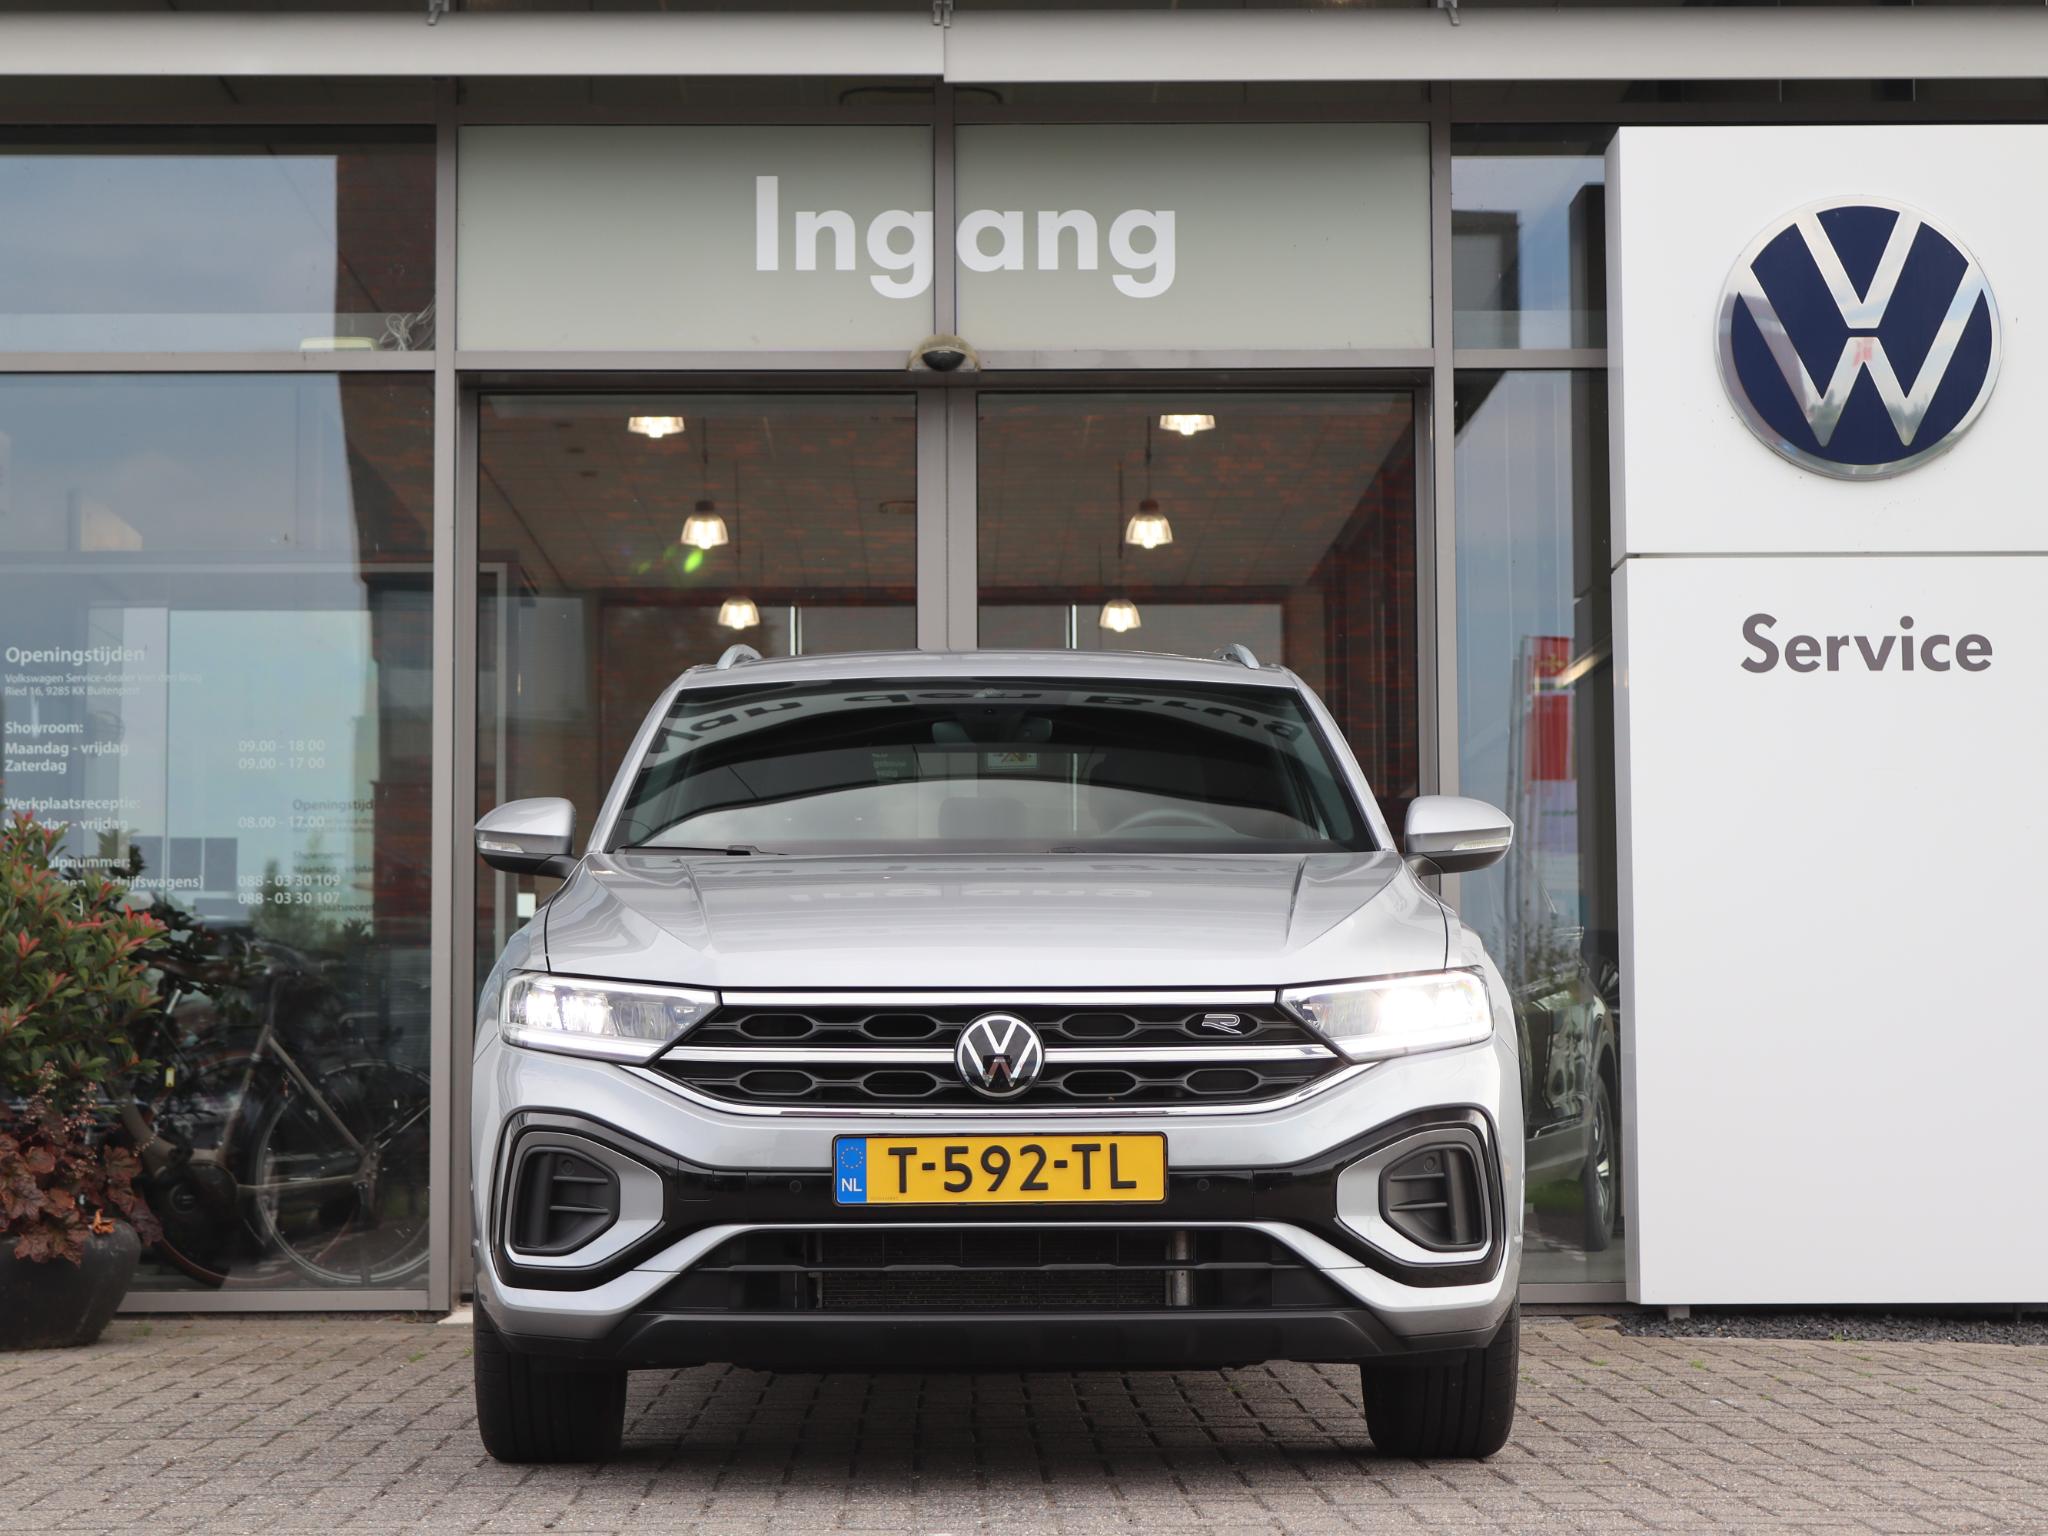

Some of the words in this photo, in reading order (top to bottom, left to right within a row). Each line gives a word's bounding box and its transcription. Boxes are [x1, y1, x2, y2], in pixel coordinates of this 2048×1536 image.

[756, 175, 1176, 299] Ingang
[1741, 613, 1993, 674] Service
[5, 646, 145, 666] Openingstijden
[5, 673, 64, 685] Volkswagen
[5, 686, 28, 696] Ried
[46, 686, 70, 696] 9285
[72, 686, 86, 696] KK
[5, 722, 84, 735] Showroom:
[5, 742, 69, 757] Maandag
[80, 742, 129, 757] vrijdag
[238, 740, 277, 753] 09.00
[5, 760, 67, 774] Zaterdag
[238, 757, 277, 769] 09.00
[4, 796, 142, 812] Werkplaatsreceptie:
[80, 817, 129, 831] vrijdag
[238, 816, 277, 829] 08.00
[288, 816, 326, 828] 17.00
[100, 875, 205, 891] drijfswagens)
[238, 875, 264, 887] 088
[274, 875, 292, 887] 03
[295, 875, 312, 887] 30
[317, 875, 341, 887] 109
[238, 892, 264, 905] 088
[274, 892, 292, 905] 03
[295, 892, 312, 905] 30
[317, 892, 341, 905] 107
[841, 1177, 862, 1193] NL
[888, 1143, 1138, 1194] T-592-TL
